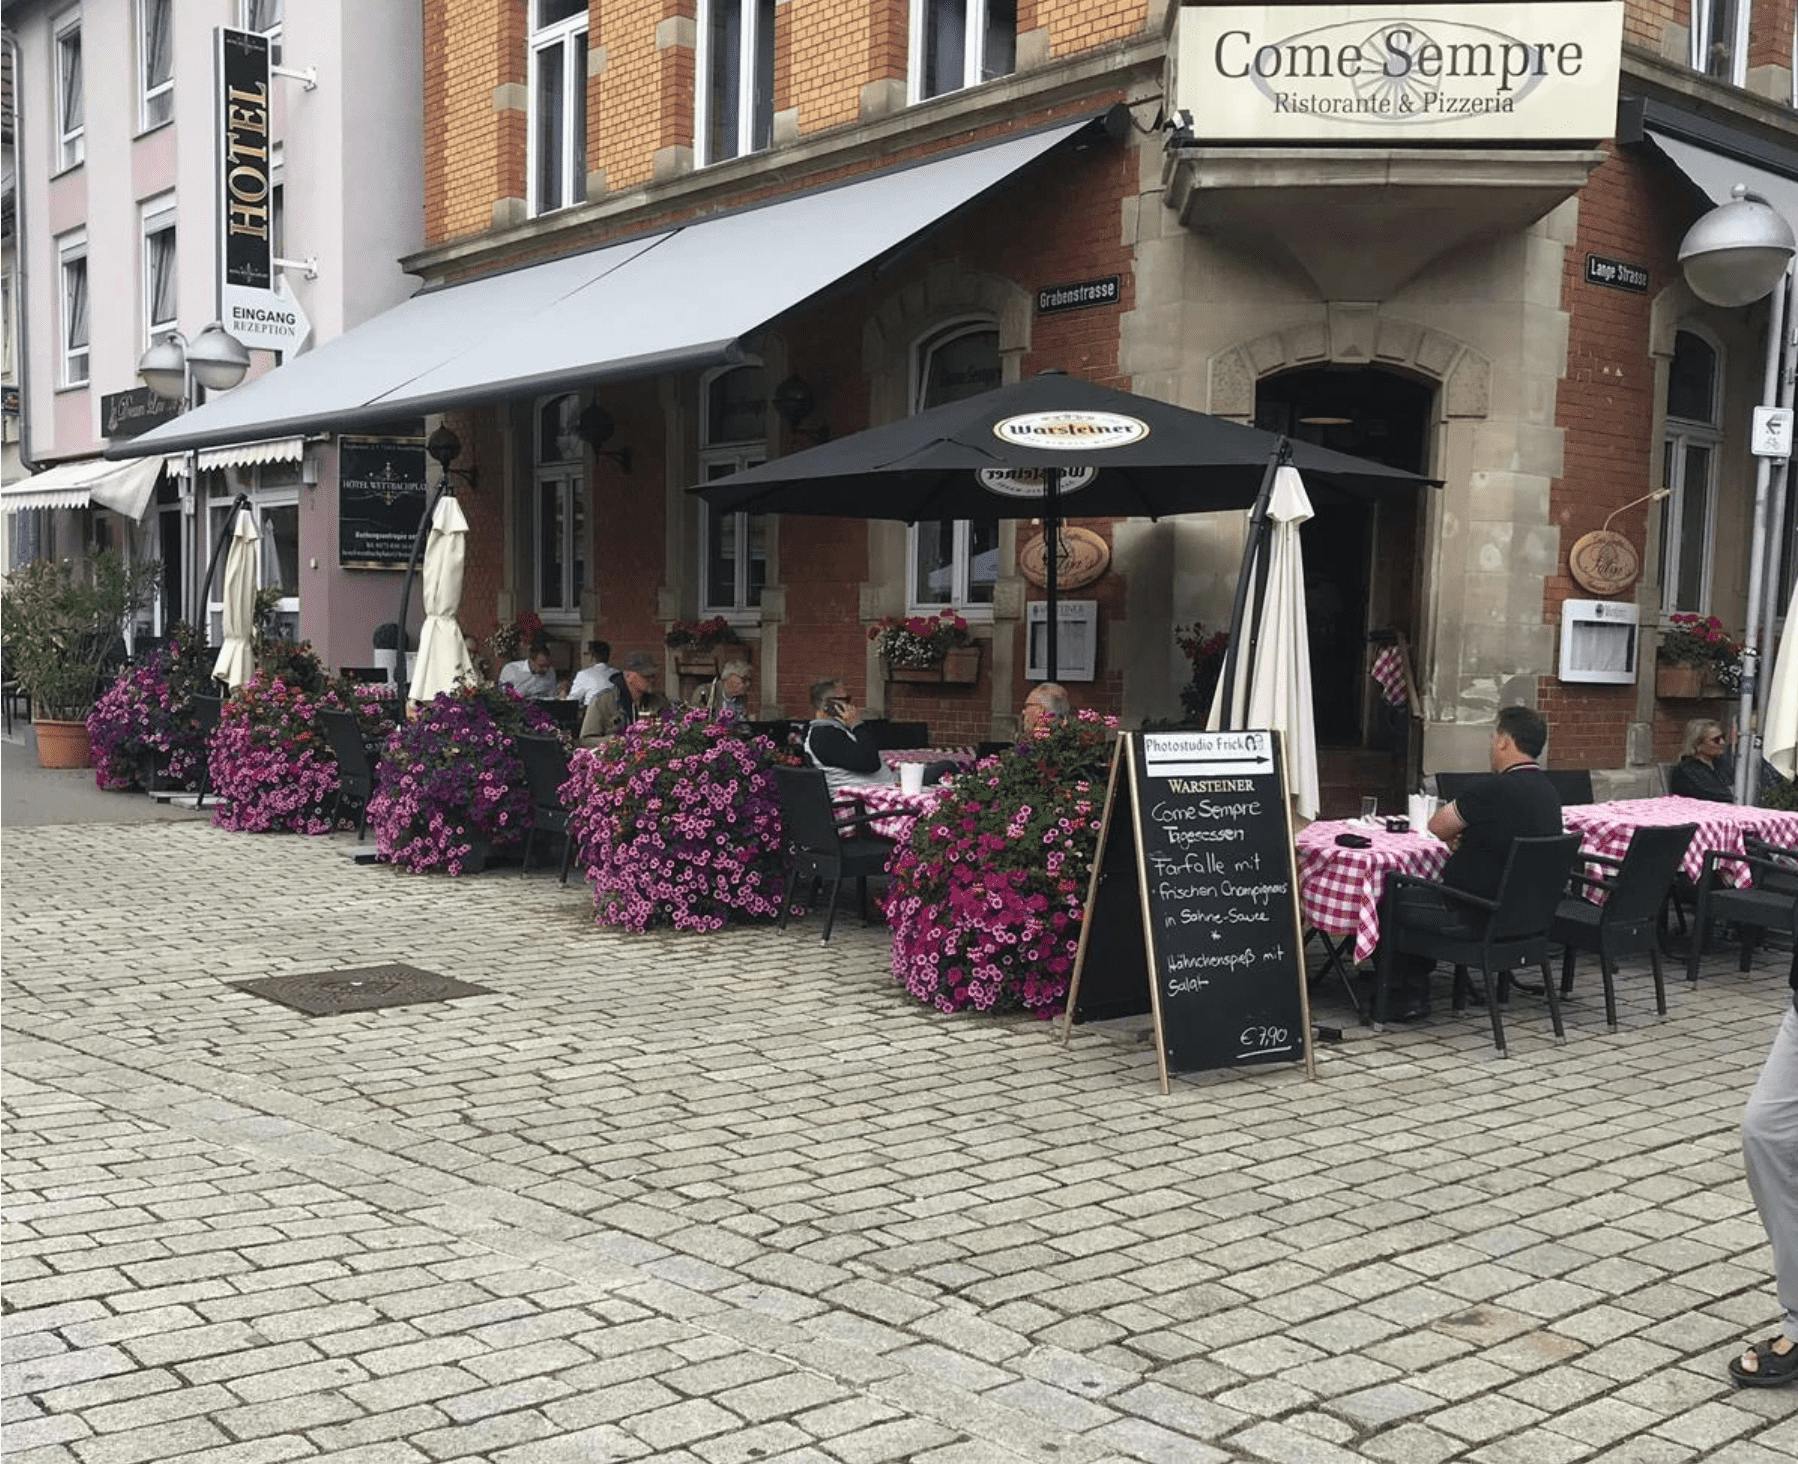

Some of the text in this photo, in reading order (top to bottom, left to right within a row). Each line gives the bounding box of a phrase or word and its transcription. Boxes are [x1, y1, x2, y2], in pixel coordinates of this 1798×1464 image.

[1215, 29, 1583, 91] Come Sempre
[1274, 92, 1514, 113] Ristorante & Pizzeria
[227, 81, 268, 241] HOTEL
[1591, 258, 1648, 286] Lange Strasse
[1040, 283, 1115, 308] Grabenstrasse
[233, 306, 296, 325] EINGANG
[233, 320, 296, 336] REZEPTION
[1009, 423, 1134, 436] Warsteiner
[1146, 736, 1244, 752] Photostudio Frick
[1152, 799, 1262, 822] Come Sempre
[1162, 826, 1244, 850] Tagesessen
[1150, 852, 1260, 876] Farfalle mit
[1164, 912, 1176, 928] in
[1167, 944, 1284, 972] Hähnchenspieß mit
[1167, 976, 1209, 996] Salat
